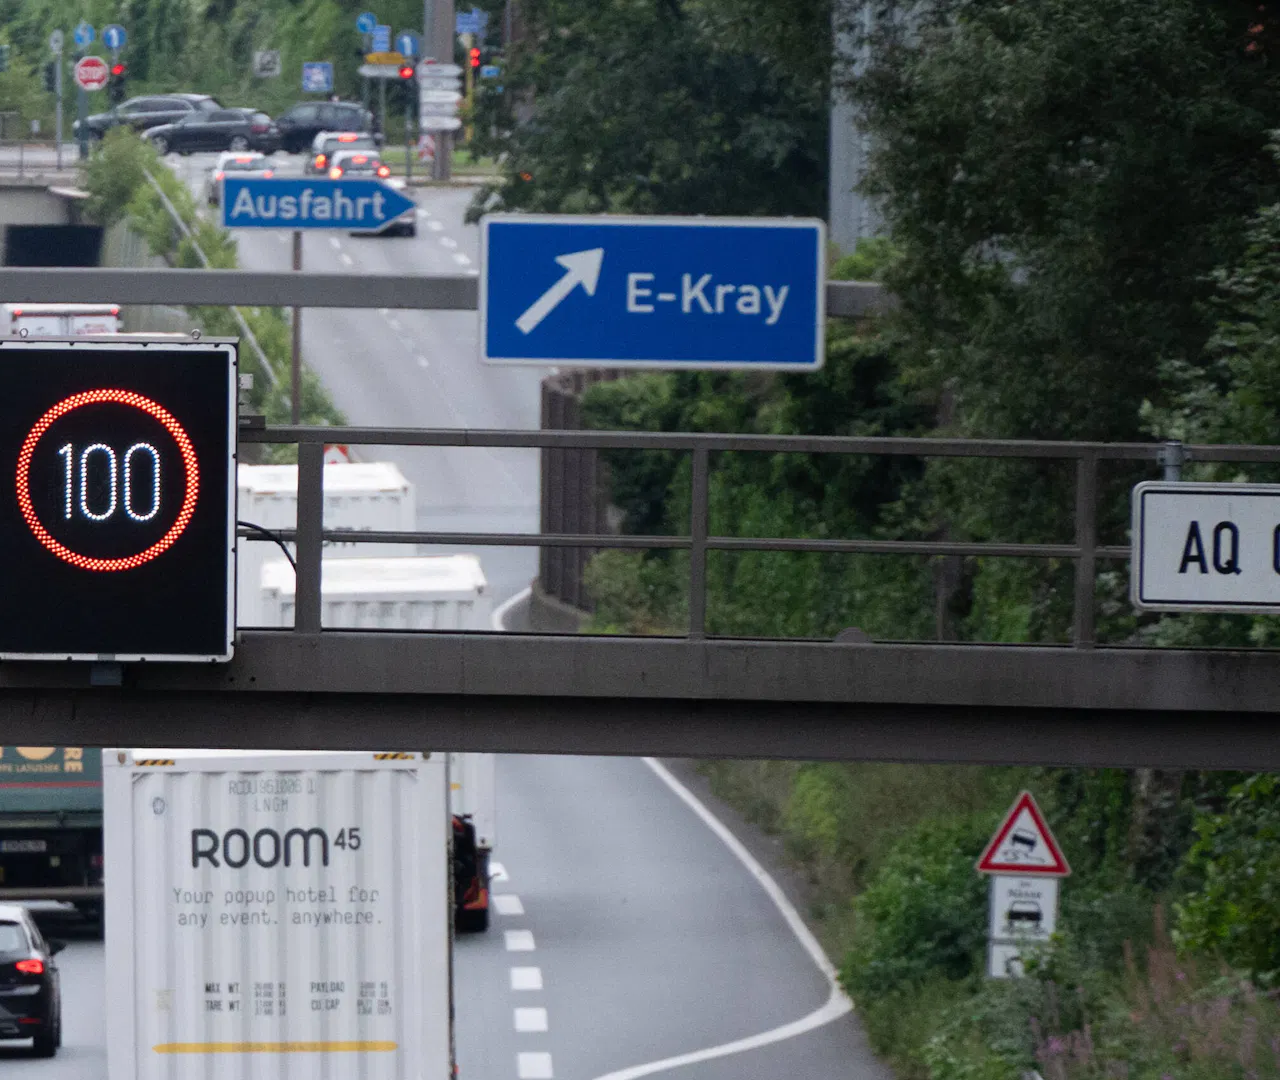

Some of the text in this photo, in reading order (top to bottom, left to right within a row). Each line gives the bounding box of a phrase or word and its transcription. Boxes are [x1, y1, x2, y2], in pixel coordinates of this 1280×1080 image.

[79, 66, 107, 80] STOP
[231, 187, 386, 220] Ausfahrt
[627, 272, 790, 326] E-Kray
[58, 443, 161, 521] 100
[1178, 520, 1242, 575] AQ
[173, 886, 380, 906] Your popup hotel for
[178, 912, 208, 928] any
[292, 910, 383, 928] anywhere.
[311, 982, 345, 993] PAYLOAD
